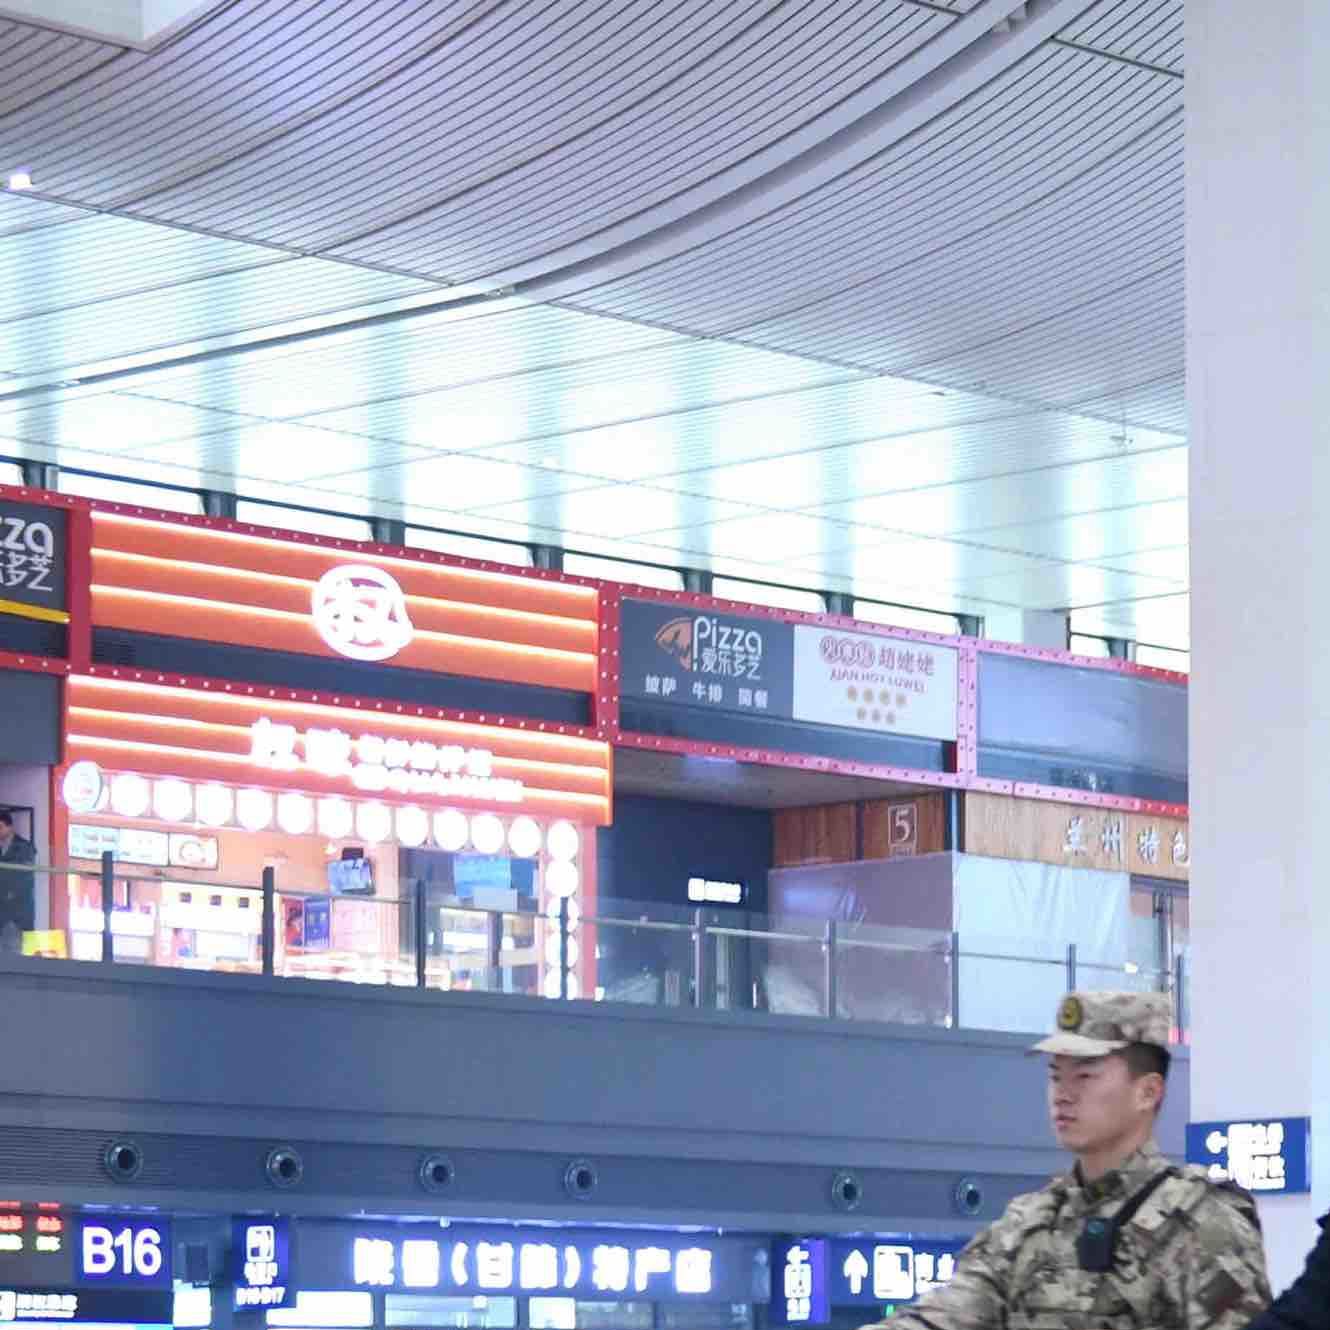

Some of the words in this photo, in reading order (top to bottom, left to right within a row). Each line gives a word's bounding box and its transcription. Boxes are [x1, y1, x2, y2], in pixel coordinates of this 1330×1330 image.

[0, 515, 54, 557] za
[693, 616, 762, 661] Pizza
[894, 810, 911, 844] 5
[83, 1226, 162, 1276] B16
